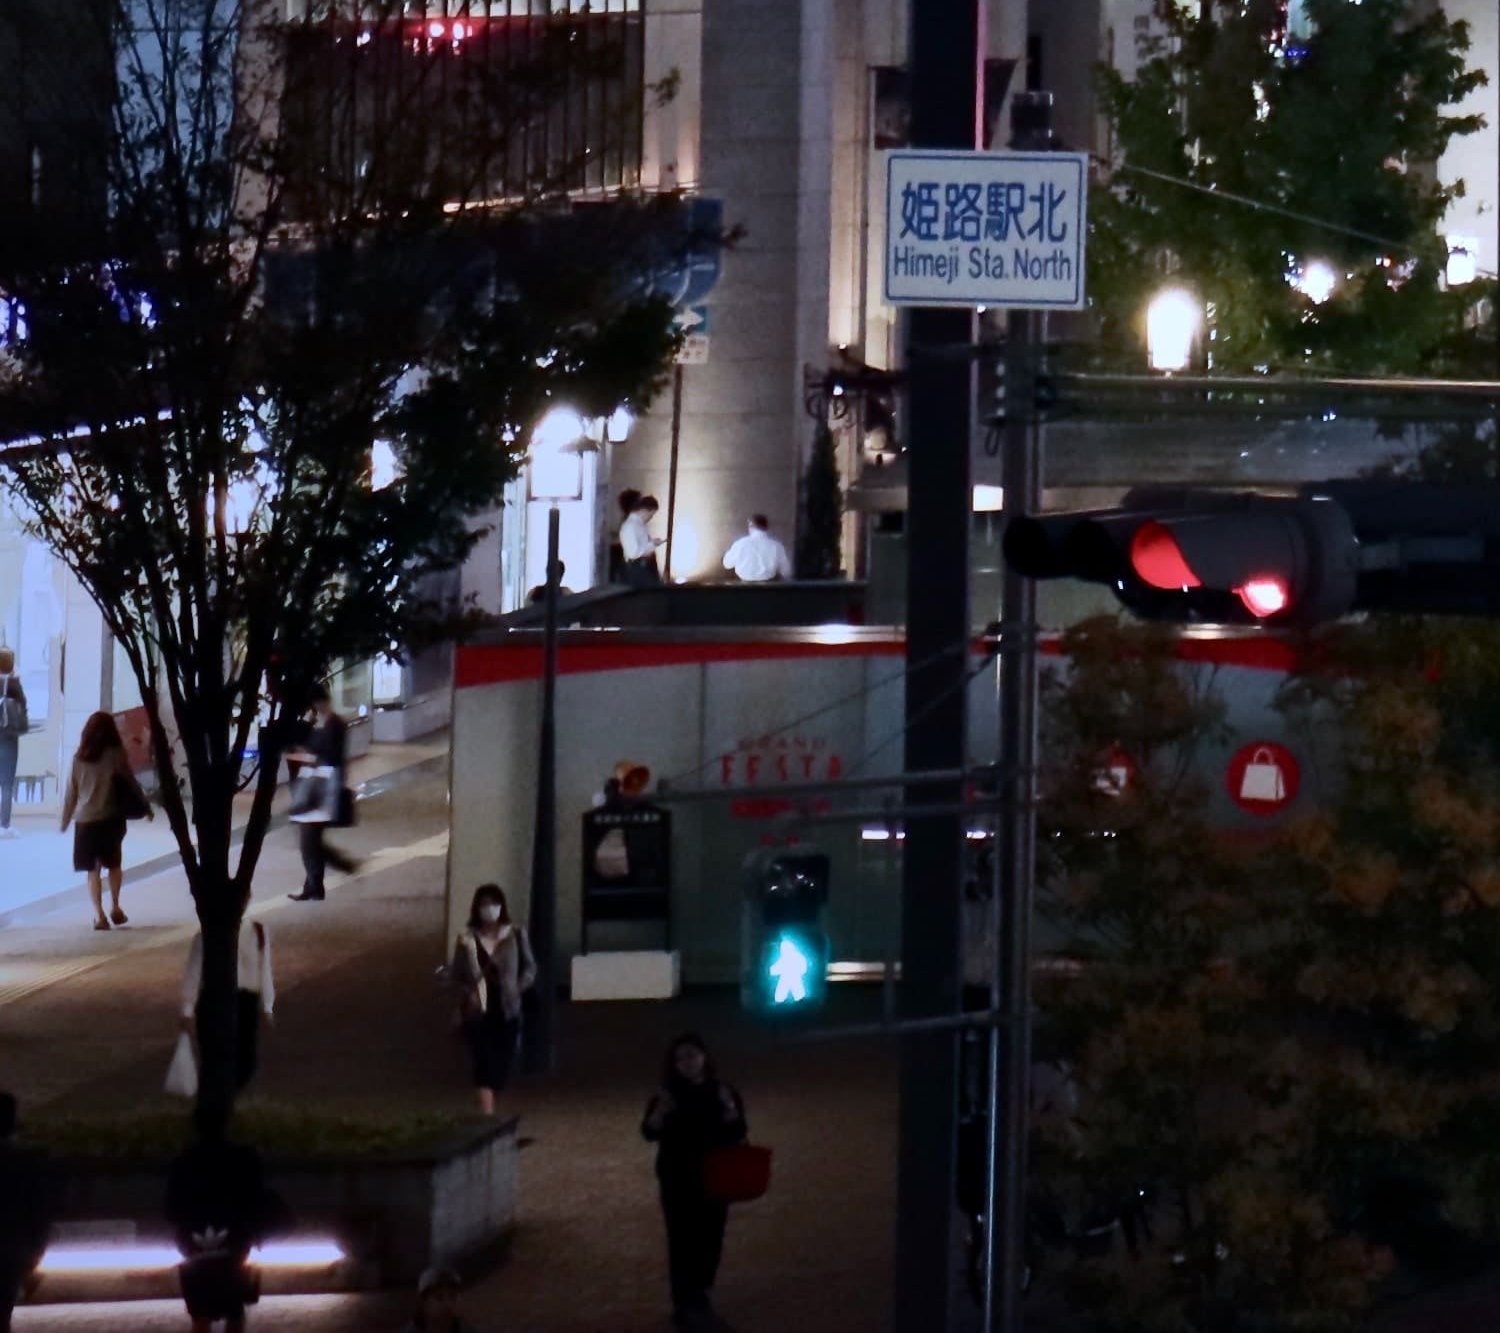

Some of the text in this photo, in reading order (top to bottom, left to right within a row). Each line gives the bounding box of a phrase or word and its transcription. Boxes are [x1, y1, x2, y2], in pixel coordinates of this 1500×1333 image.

[900, 180, 1068, 243] 姫路駅北
[893, 245, 1072, 284] Himeji Sta. North
